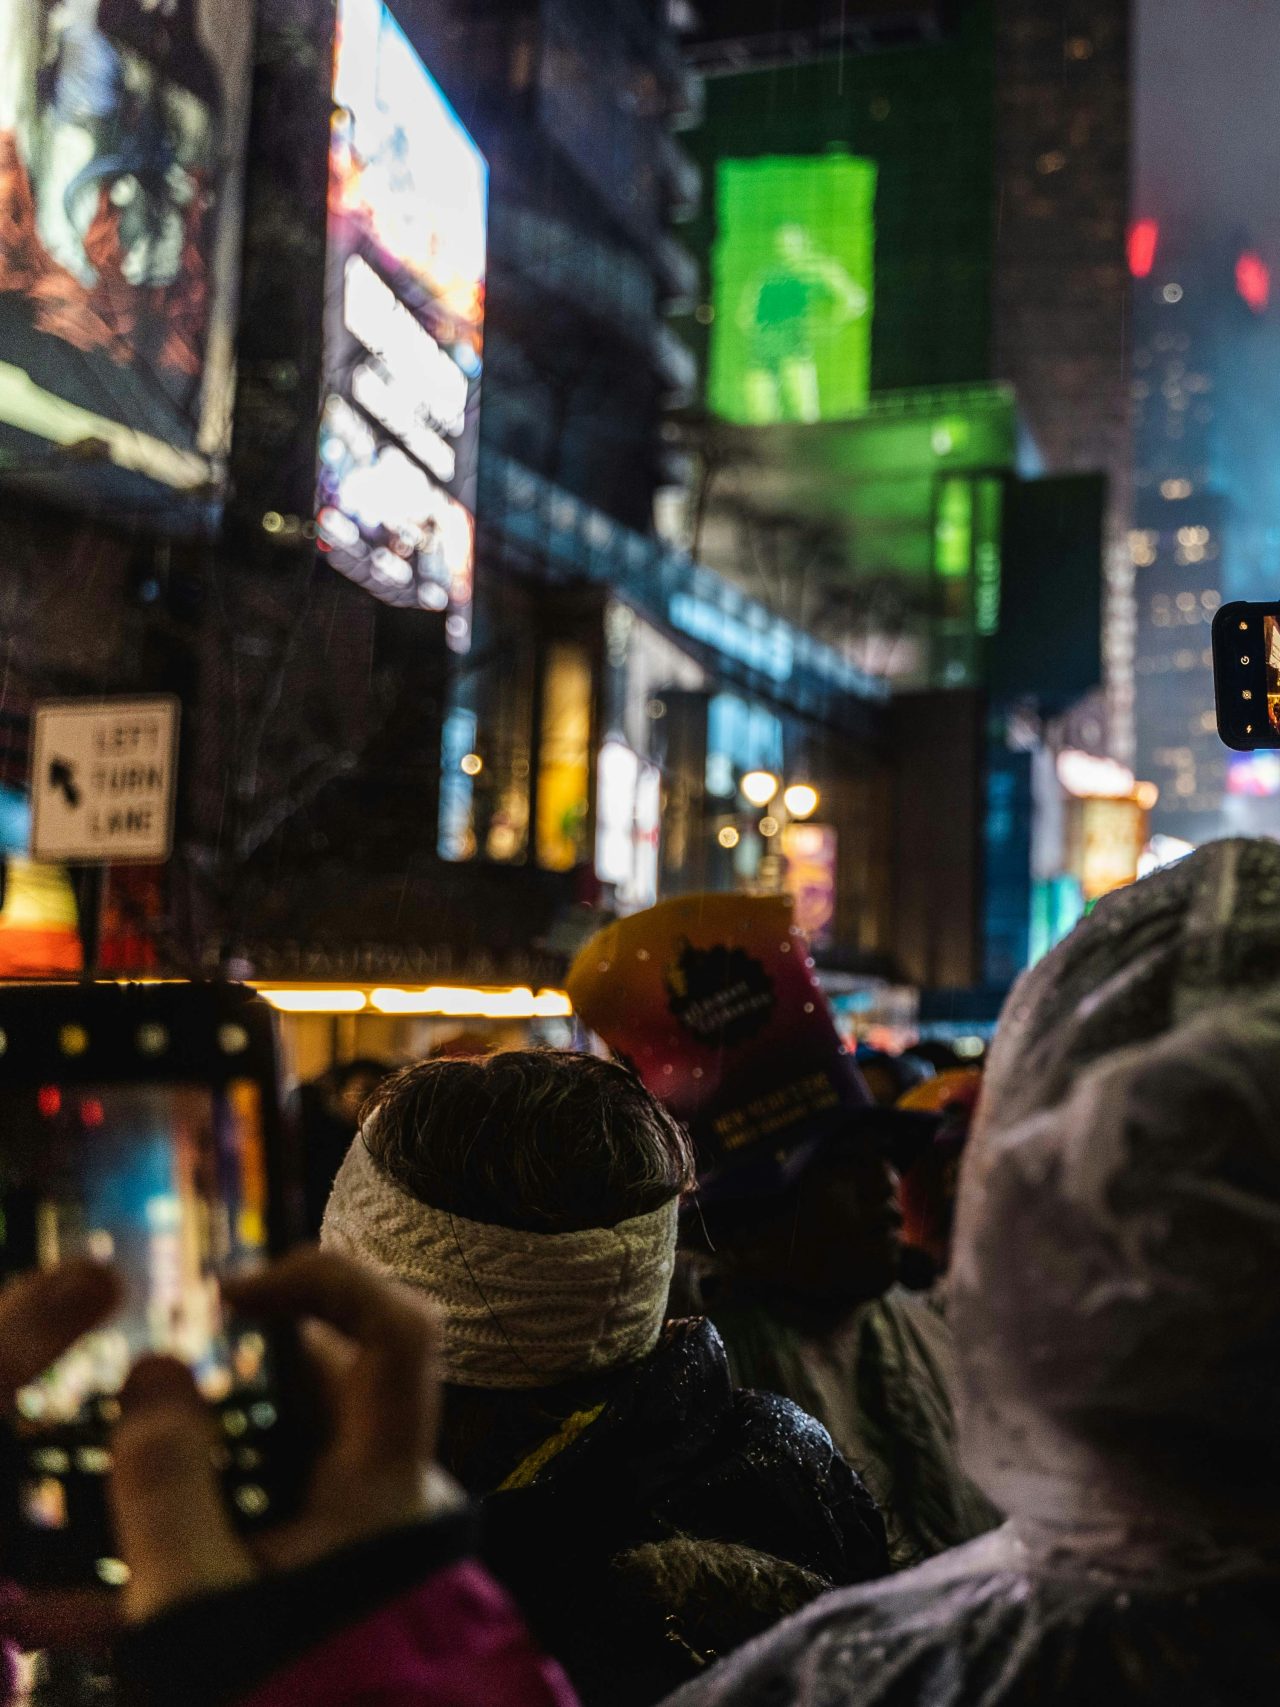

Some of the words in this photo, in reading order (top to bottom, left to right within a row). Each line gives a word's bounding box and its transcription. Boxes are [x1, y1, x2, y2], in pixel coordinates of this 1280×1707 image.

[92, 717, 161, 757] LEFT
[92, 762, 165, 795] TURN
[87, 808, 153, 841] LANE
